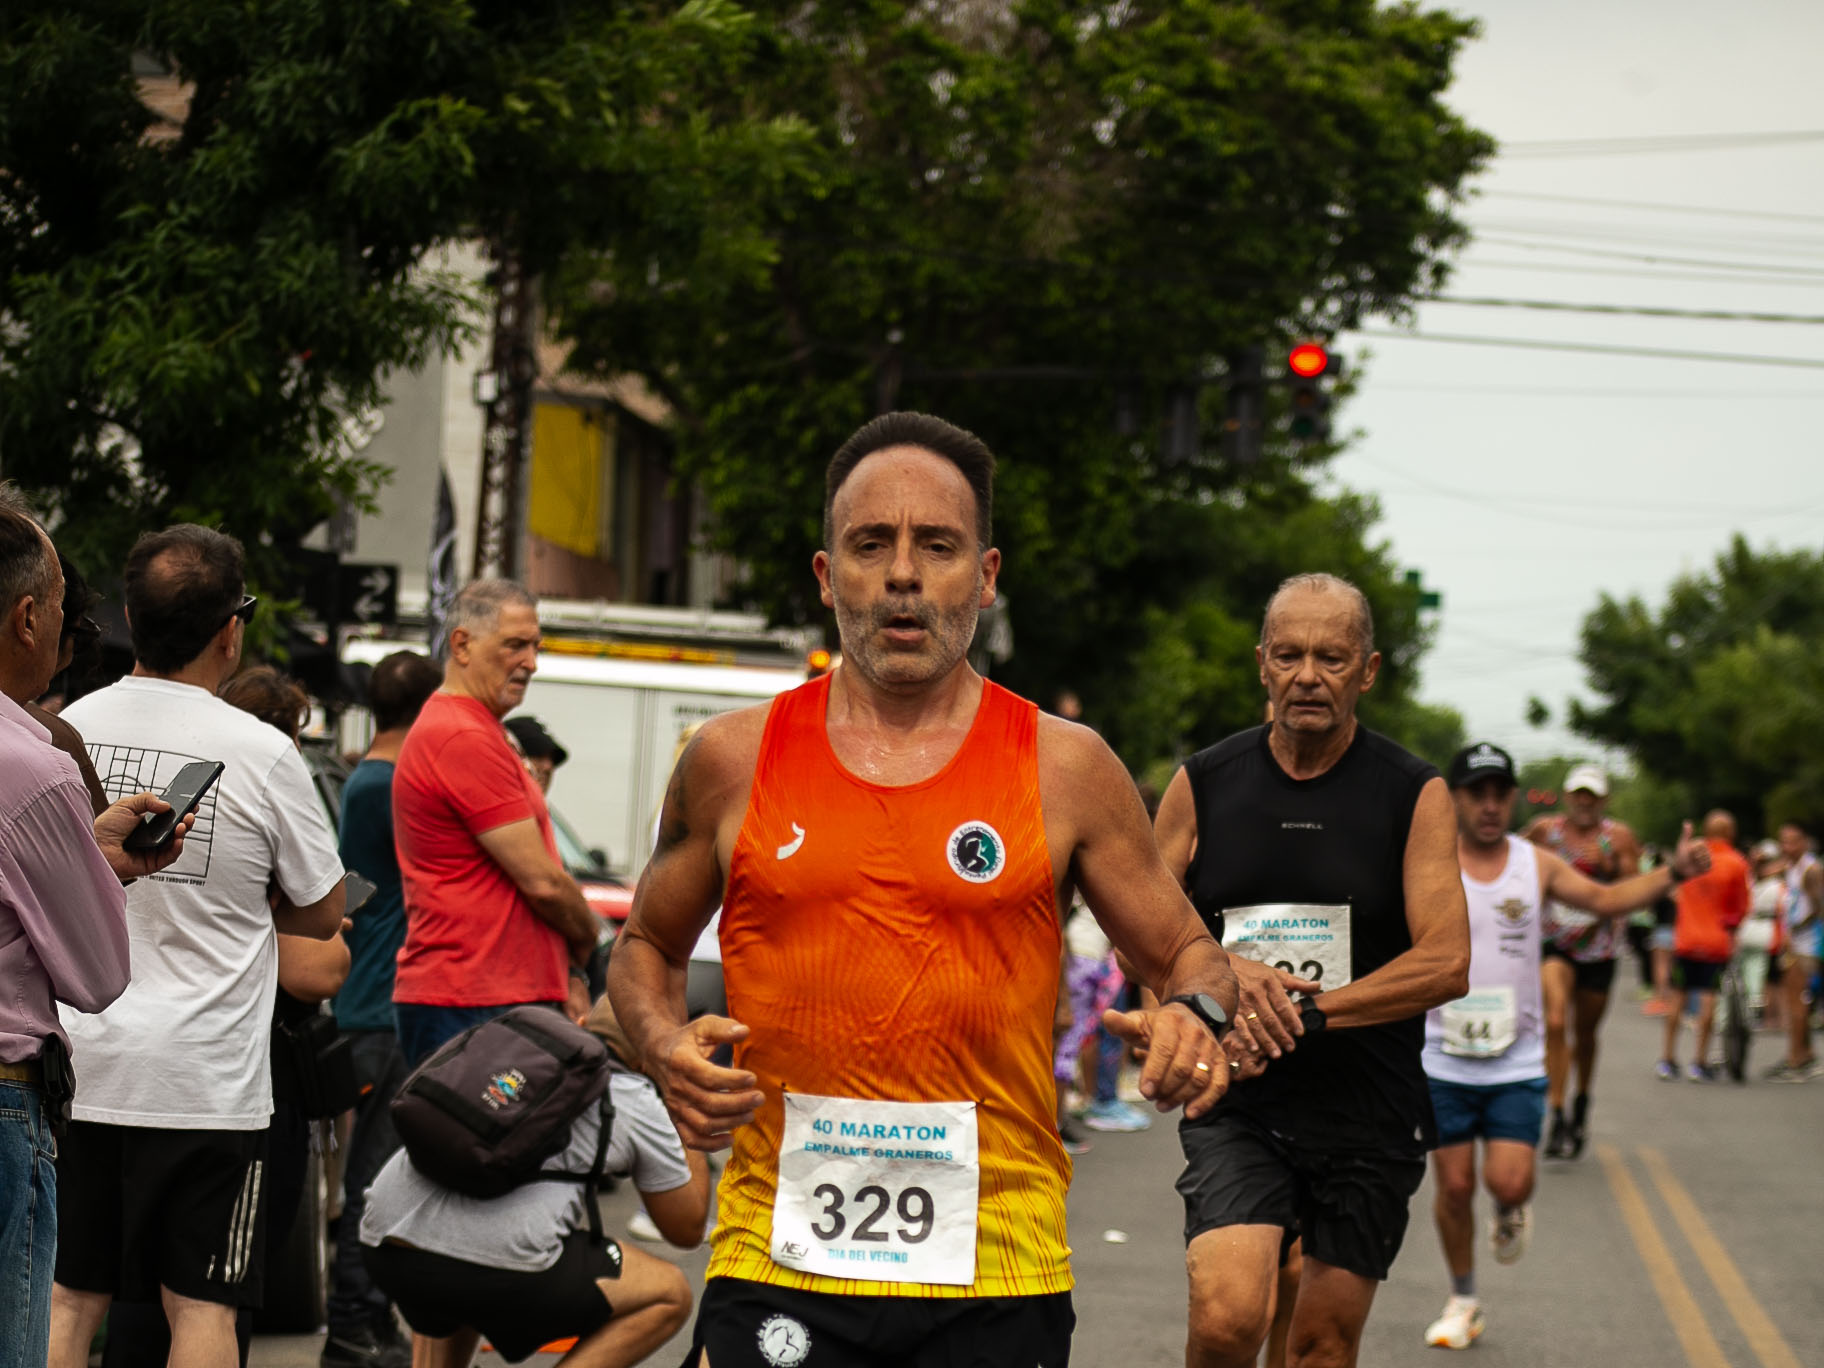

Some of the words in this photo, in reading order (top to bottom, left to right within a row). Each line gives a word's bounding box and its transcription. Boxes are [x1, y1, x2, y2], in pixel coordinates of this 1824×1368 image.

[1243, 920, 1258, 930] 40
[1261, 918, 1330, 930] MARATON
[1282, 934, 1334, 943] GRANEROS
[812, 1117, 833, 1135] 40
[840, 1123, 946, 1140] MARATON
[804, 1141, 870, 1158] EMPALME
[873, 1147, 954, 1161] GRANEROS
[811, 1183, 935, 1244] 329
[848, 1249, 866, 1261] DEL
[869, 1250, 909, 1264] VECINO
